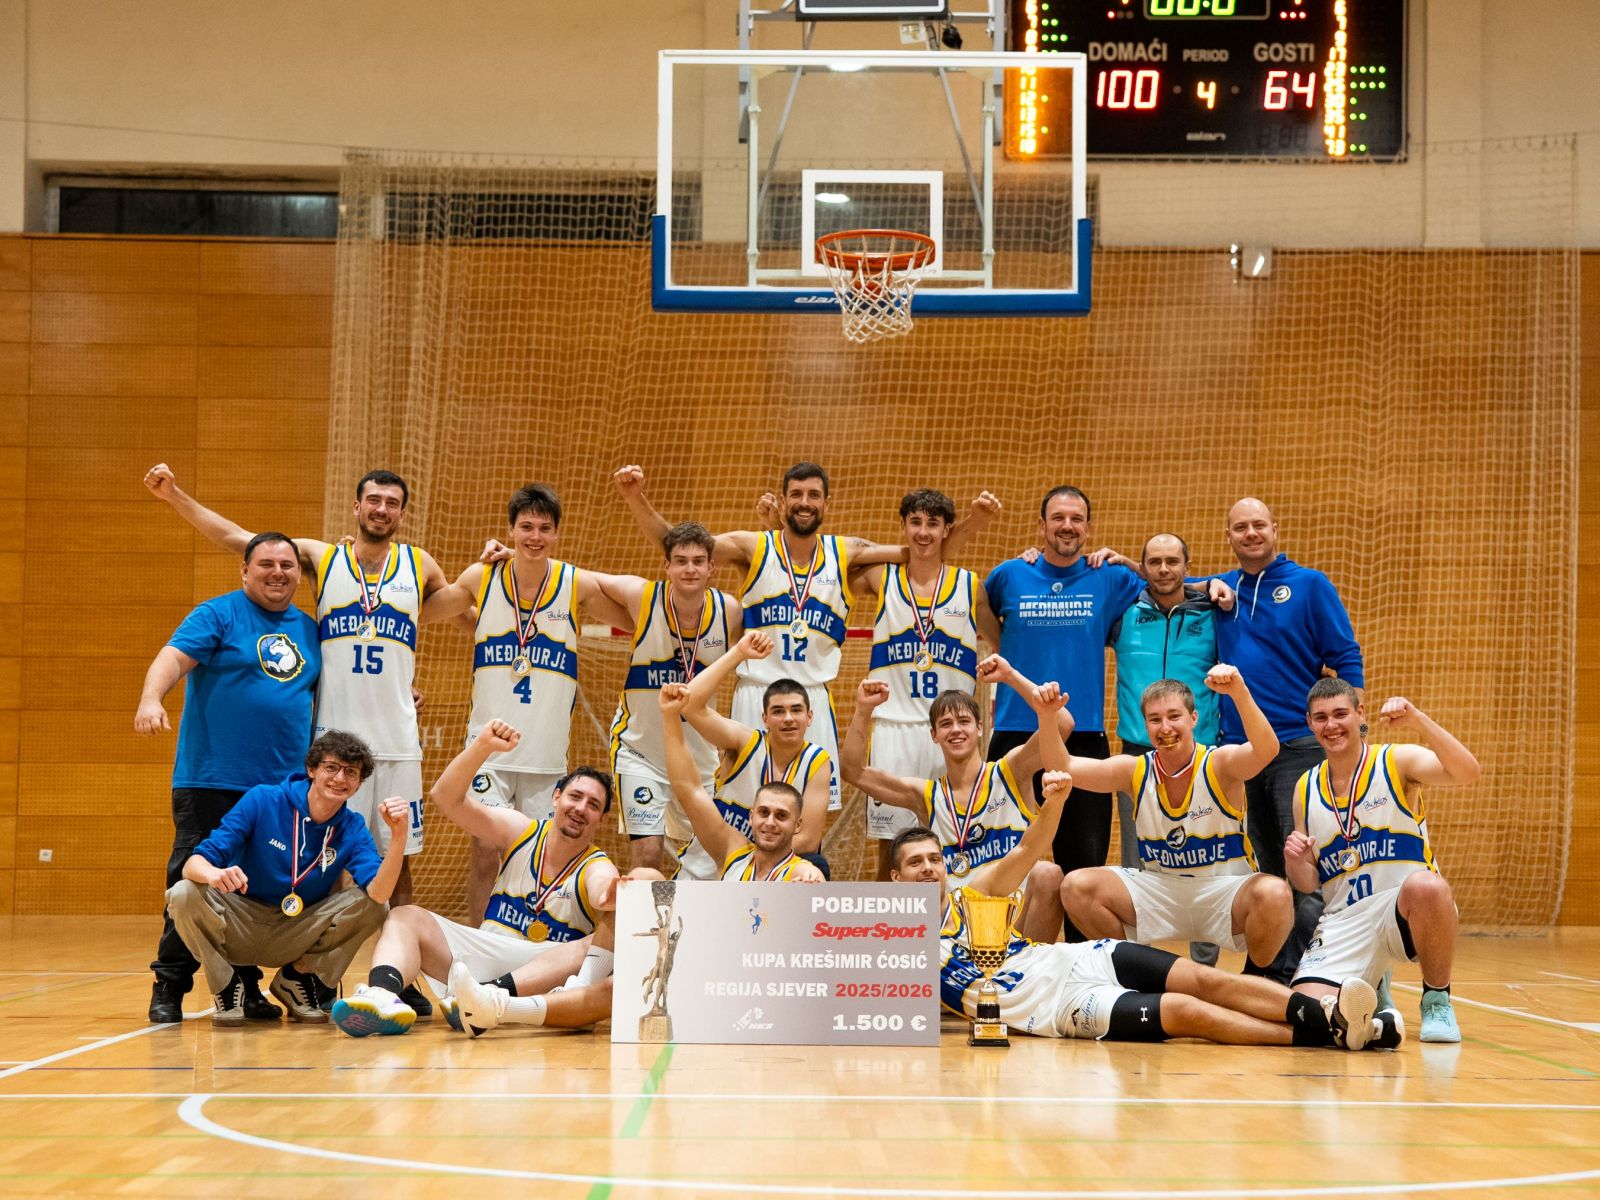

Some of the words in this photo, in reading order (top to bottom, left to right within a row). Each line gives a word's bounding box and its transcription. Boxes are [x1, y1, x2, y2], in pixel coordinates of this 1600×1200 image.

[1089, 38, 1168, 62] DOMAĆI
[1183, 48, 1229, 62] PERIOD
[1254, 42, 1314, 62] GOSTI
[1097, 70, 1160, 109] 100
[1197, 81, 1216, 109] 4
[1264, 71, 1316, 109] 64
[782, 633, 809, 662] 12
[352, 644, 384, 675] 15
[513, 676, 532, 704] 4
[909, 671, 938, 699] 18
[268, 838, 287, 851] JAKO
[811, 896, 927, 914] POBJEDNIK
[812, 922, 927, 940] SuperSport
[742, 953, 786, 969] KUPA
[791, 950, 872, 969] KREŠIMIR
[877, 950, 927, 969] ĆOSIĆ
[704, 982, 761, 997] REGIJA
[766, 982, 828, 998] SJEVER
[835, 983, 933, 998] 2025/2026
[832, 1014, 904, 1031] 1.500
[911, 1014, 927, 1031] €
